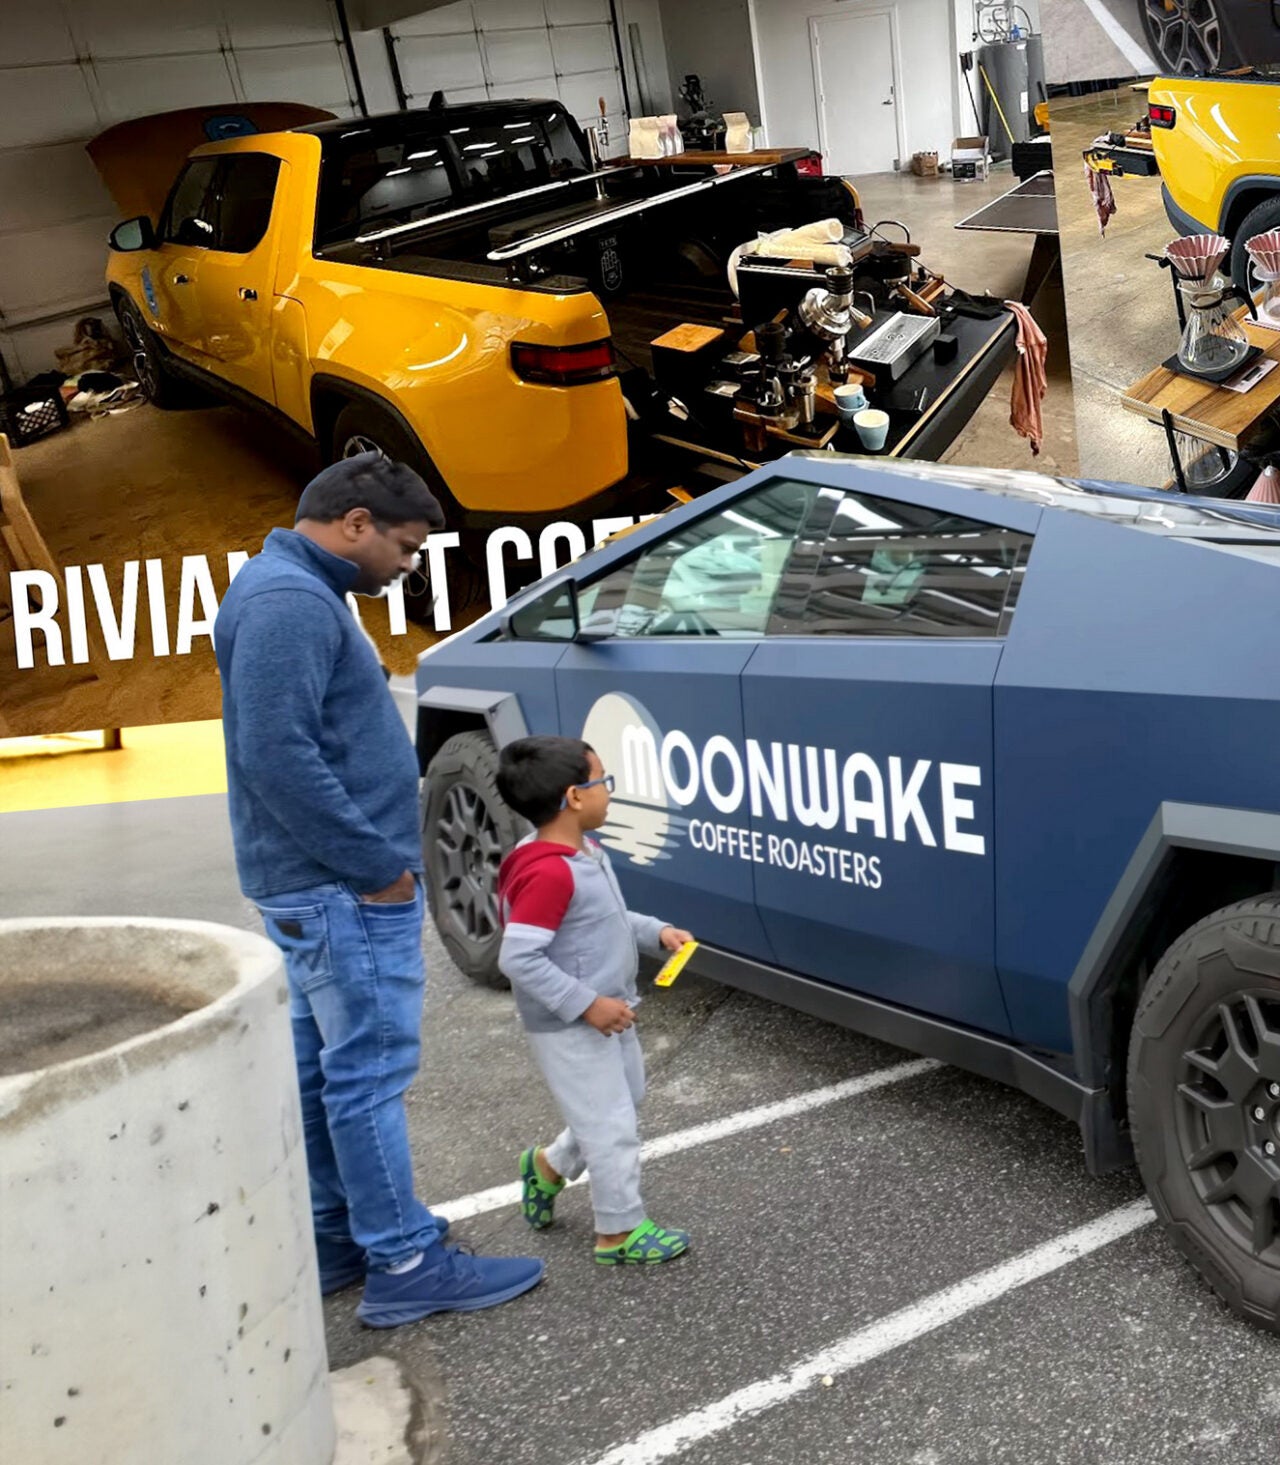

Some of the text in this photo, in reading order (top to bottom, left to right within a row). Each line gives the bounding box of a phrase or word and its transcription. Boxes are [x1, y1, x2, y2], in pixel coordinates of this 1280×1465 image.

[621, 724, 986, 855] MOONWAKE
[689, 818, 883, 889] COFFEE ROASTERS
